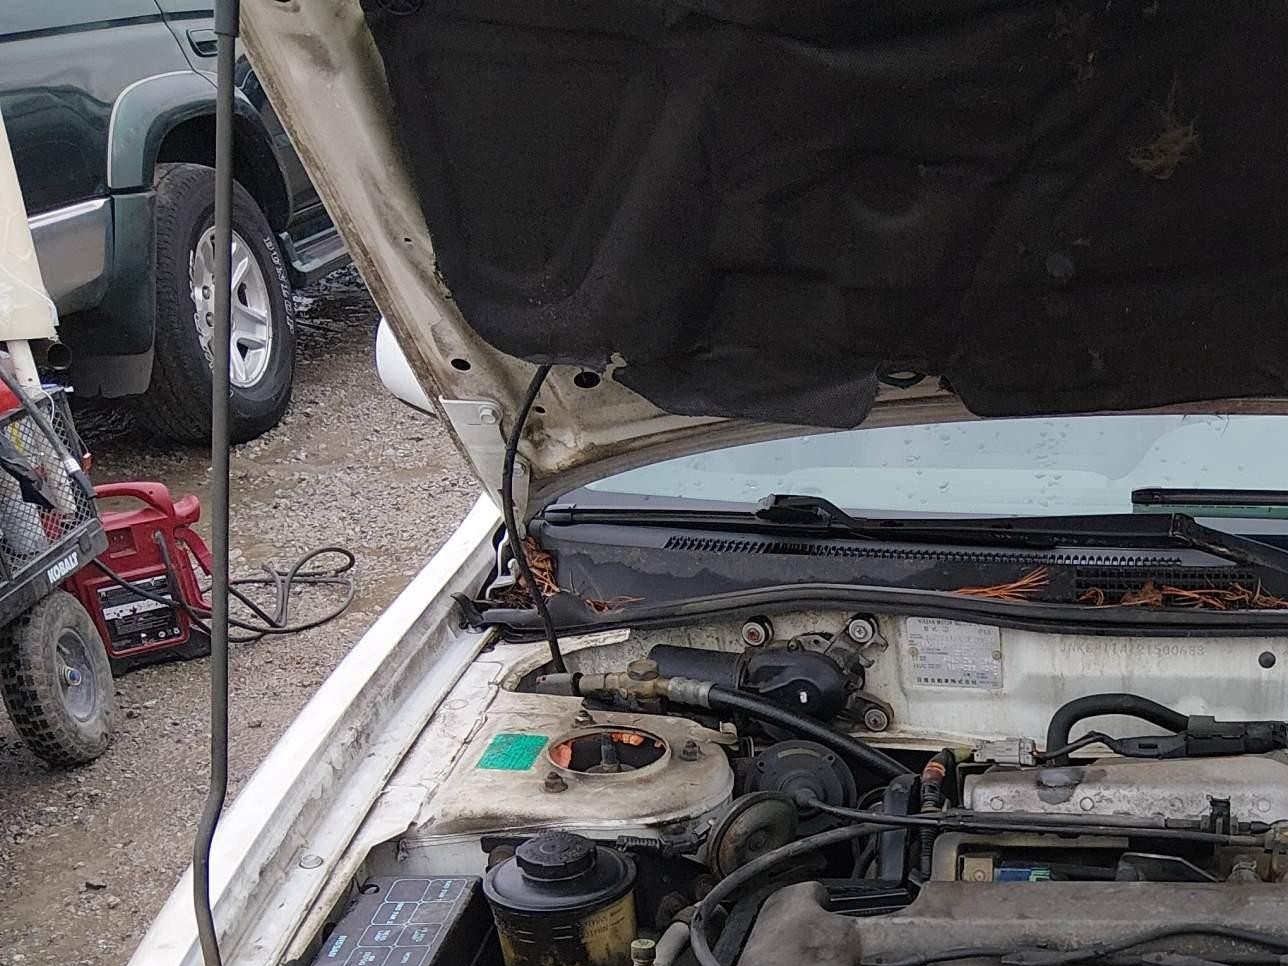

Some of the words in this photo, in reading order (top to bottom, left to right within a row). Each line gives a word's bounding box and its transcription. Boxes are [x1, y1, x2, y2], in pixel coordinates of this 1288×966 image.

[263, 235, 295, 335] DUNLOP
[46, 551, 80, 584] KOBALT
[327, 935, 347, 957] NISSAN
